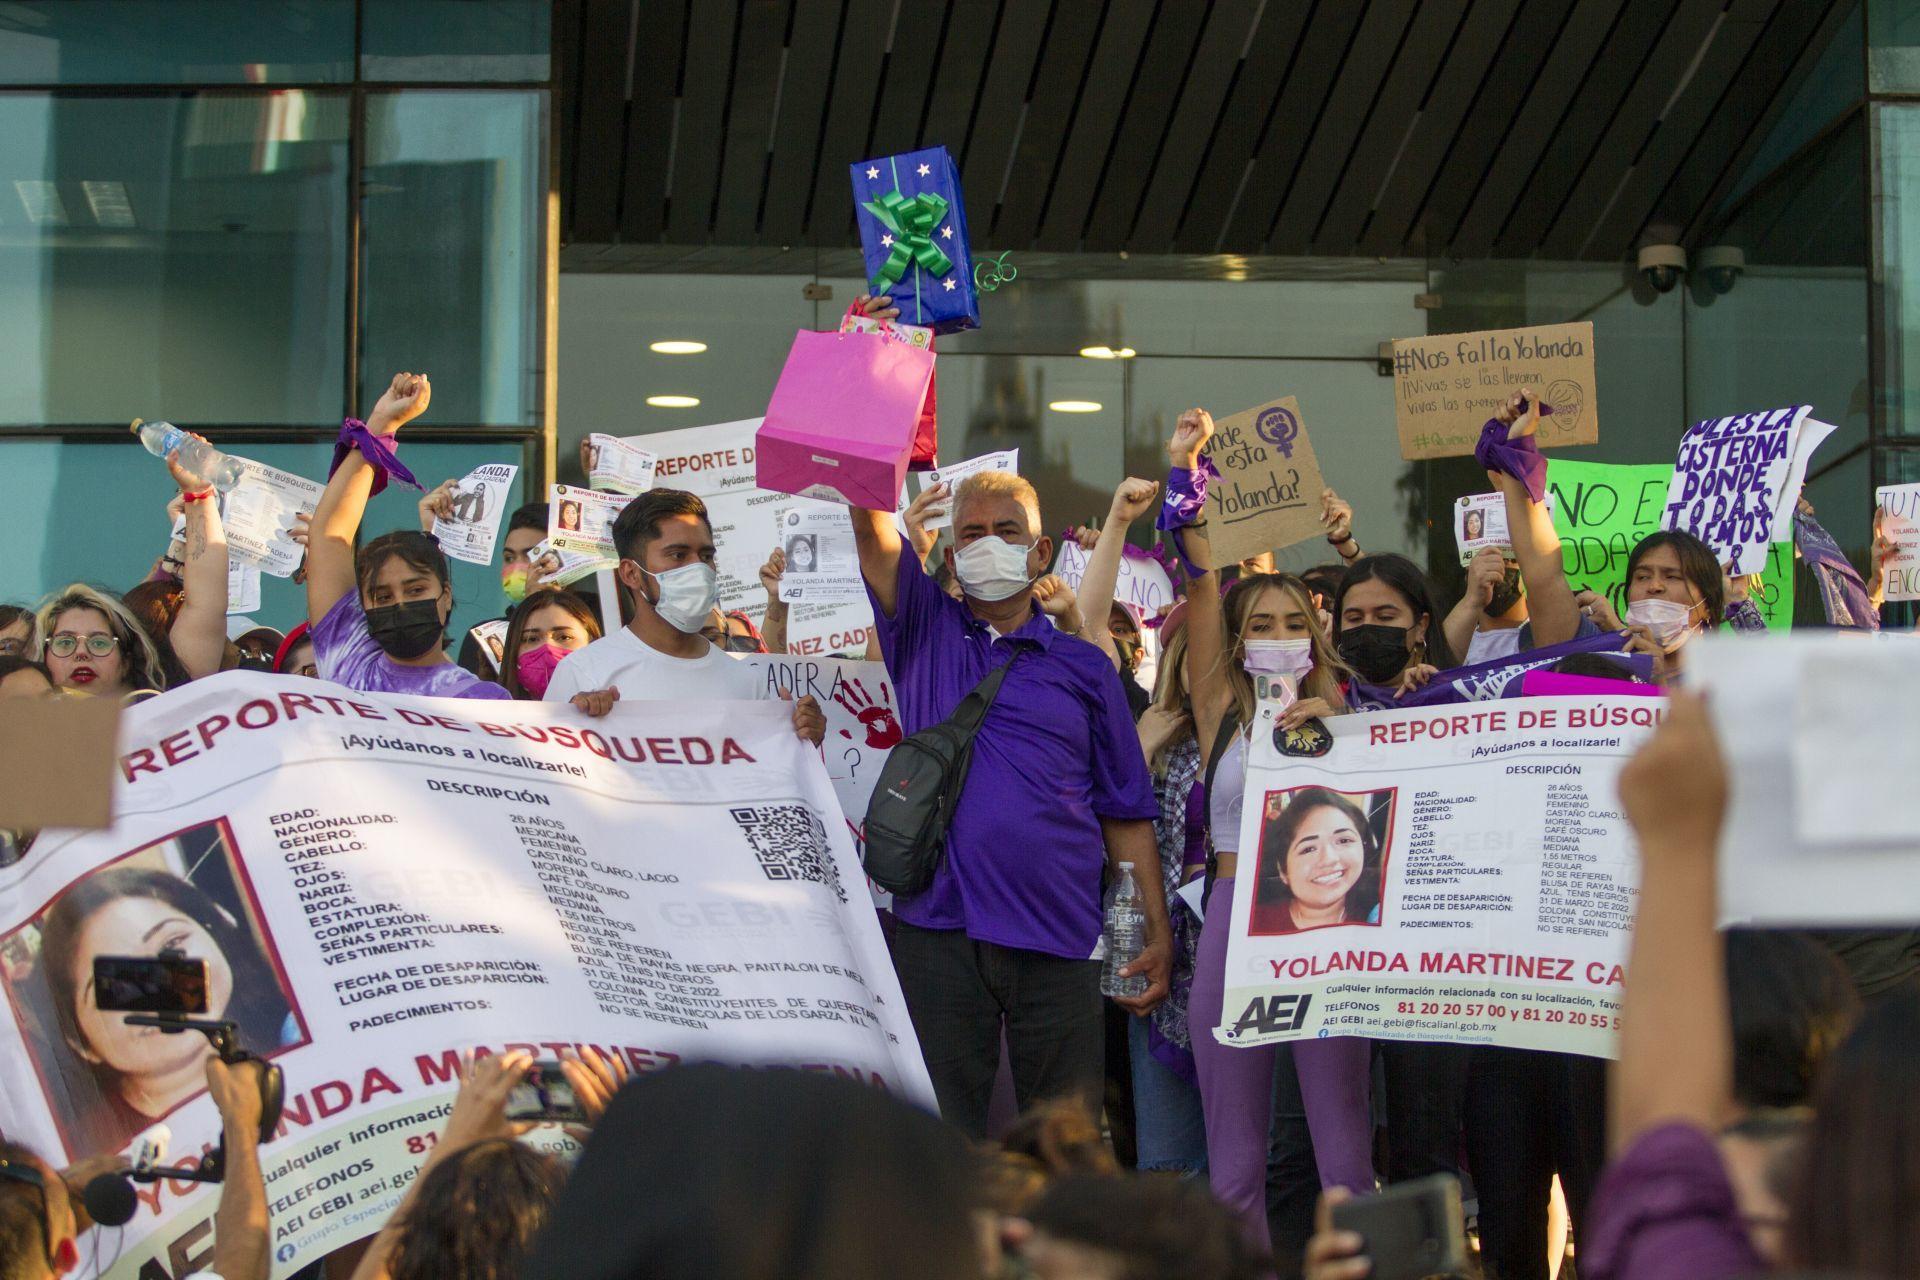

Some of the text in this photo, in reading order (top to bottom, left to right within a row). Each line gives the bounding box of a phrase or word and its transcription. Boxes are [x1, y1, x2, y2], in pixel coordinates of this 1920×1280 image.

[1395, 347, 1449, 374] #Nos
[1514, 335, 1583, 360] Yolanda
[1757, 406, 1799, 432] LA
[1226, 441, 1268, 471] esta
[1675, 430, 1788, 473] CISTERNA
[263, 468, 274, 478] DE
[655, 450, 737, 477] REPORTE
[1682, 461, 1772, 501] DONDE
[1208, 468, 1300, 516] Yolanda?
[1550, 482, 1619, 528] NO
[1667, 488, 1772, 532] TODAS
[1878, 491, 1905, 518] TU
[784, 588, 803, 598] AEI
[1131, 576, 1162, 610] NO
[1370, 709, 1558, 746] REPORTE DE
[118, 692, 757, 783] REPORTE DE BÚSQUEDA
[340, 734, 588, 779] ¡Ayúdanos a localizarle!
[1470, 737, 1621, 758] ¡Ayúdanos localizarle!
[1505, 763, 1582, 775] DESCRIPCIÓN
[426, 778, 551, 806] DESCRIPCIÓN
[1415, 790, 1440, 799] EDAD:
[1547, 792, 1589, 801] MEXICANA
[1558, 783, 1583, 792] AÑOS
[1412, 805, 1452, 815] GÉNERO:
[1413, 796, 1478, 808] NACIONALIDAD:
[1546, 801, 1590, 809] FEMENINO
[268, 807, 320, 825] EDAD:
[528, 814, 565, 831] AÑOS
[1412, 814, 1454, 823] CABELLO:
[1545, 818, 1582, 827] MORENA
[1546, 808, 1587, 819] CASTAÑO
[274, 813, 399, 838] NACIONALIDAD:
[1411, 823, 1429, 831] TEZ:
[1544, 825, 1607, 836] CAFÉ OSCURO
[279, 828, 356, 850] GÉNERO:
[515, 826, 581, 845] MEXICANA
[1409, 839, 1436, 848] NARIZ:
[1410, 831, 1437, 840] OJOS:
[1543, 835, 1580, 844] MEDIANA
[284, 841, 368, 863] CABELLO:
[520, 836, 587, 857] FEMENINO
[1408, 847, 1436, 856] BOCA:
[1543, 844, 1580, 852] MEDIANA
[526, 848, 680, 884] CASTAÑO LACIO
[1407, 854, 1455, 862] ESTATURA:
[1542, 861, 1582, 871] REGULAR
[1561, 853, 1598, 862] METROS
[289, 861, 326, 877] TEZ:
[532, 860, 588, 879] MORENA
[1406, 867, 1503, 876] SEÑAS PARTICULARES:
[1569, 872, 1613, 881] REFIEREN
[294, 870, 347, 888] OJOS:
[1404, 877, 1461, 886] VESTIMENTA:
[1540, 879, 1615, 891] BLUSA RAYAS
[299, 882, 353, 902] NARIZ:
[543, 884, 599, 904] MEDIANA
[575, 879, 630, 900] OSCURO
[1402, 893, 1513, 903] FECHA DESAPARICIÓN:
[1567, 889, 1629, 903] TENIS NEGROS
[304, 894, 357, 914] BOCA:
[548, 895, 605, 915] MEDIANA
[1401, 902, 1514, 913] LUGAR DESAPARICIÓN:
[1564, 898, 1595, 908] MARZO
[309, 902, 403, 928] ESTATURA:
[582, 913, 636, 933] METROS
[1400, 920, 1474, 929] PADECIMIENTOS:
[314, 912, 431, 940] COMPLEXIÓN:
[560, 919, 622, 940] REGULAR
[1566, 926, 1609, 938] REFIEREN
[320, 923, 504, 953] SEÑAS PARTICULARES:
[323, 938, 435, 967] VESTIMENTA:
[608, 939, 673, 960] REFIEREN
[617, 962, 715, 986] TENIS NEGROS
[639, 956, 682, 973] RAYAS
[1269, 950, 1575, 982] YOLANDA MARTINEZ
[334, 959, 541, 993] FECHA DE DESAPARICIÓN:
[623, 974, 666, 991] MARZO
[339, 972, 549, 1006] LUGAR DE DESAPARICIÓN:
[1326, 983, 1596, 1008] Cualquier información relacionada con localización,
[655, 992, 777, 1009] CONSTITUYENTES
[349, 999, 492, 1032] PADECIMIENTOS:
[644, 1011, 710, 1031] REFIEREN
[684, 1006, 742, 1021] NICOLAS
[1232, 993, 1313, 1038] AEI
[1322, 1016, 1338, 1026] AEI
[1340, 1015, 1364, 1025] GEBI
[1324, 1002, 1608, 1029] TELEFONOS 81 20 20 57 00 y 81 20 20 55
[276, 1193, 354, 1243] AEI GEBI
